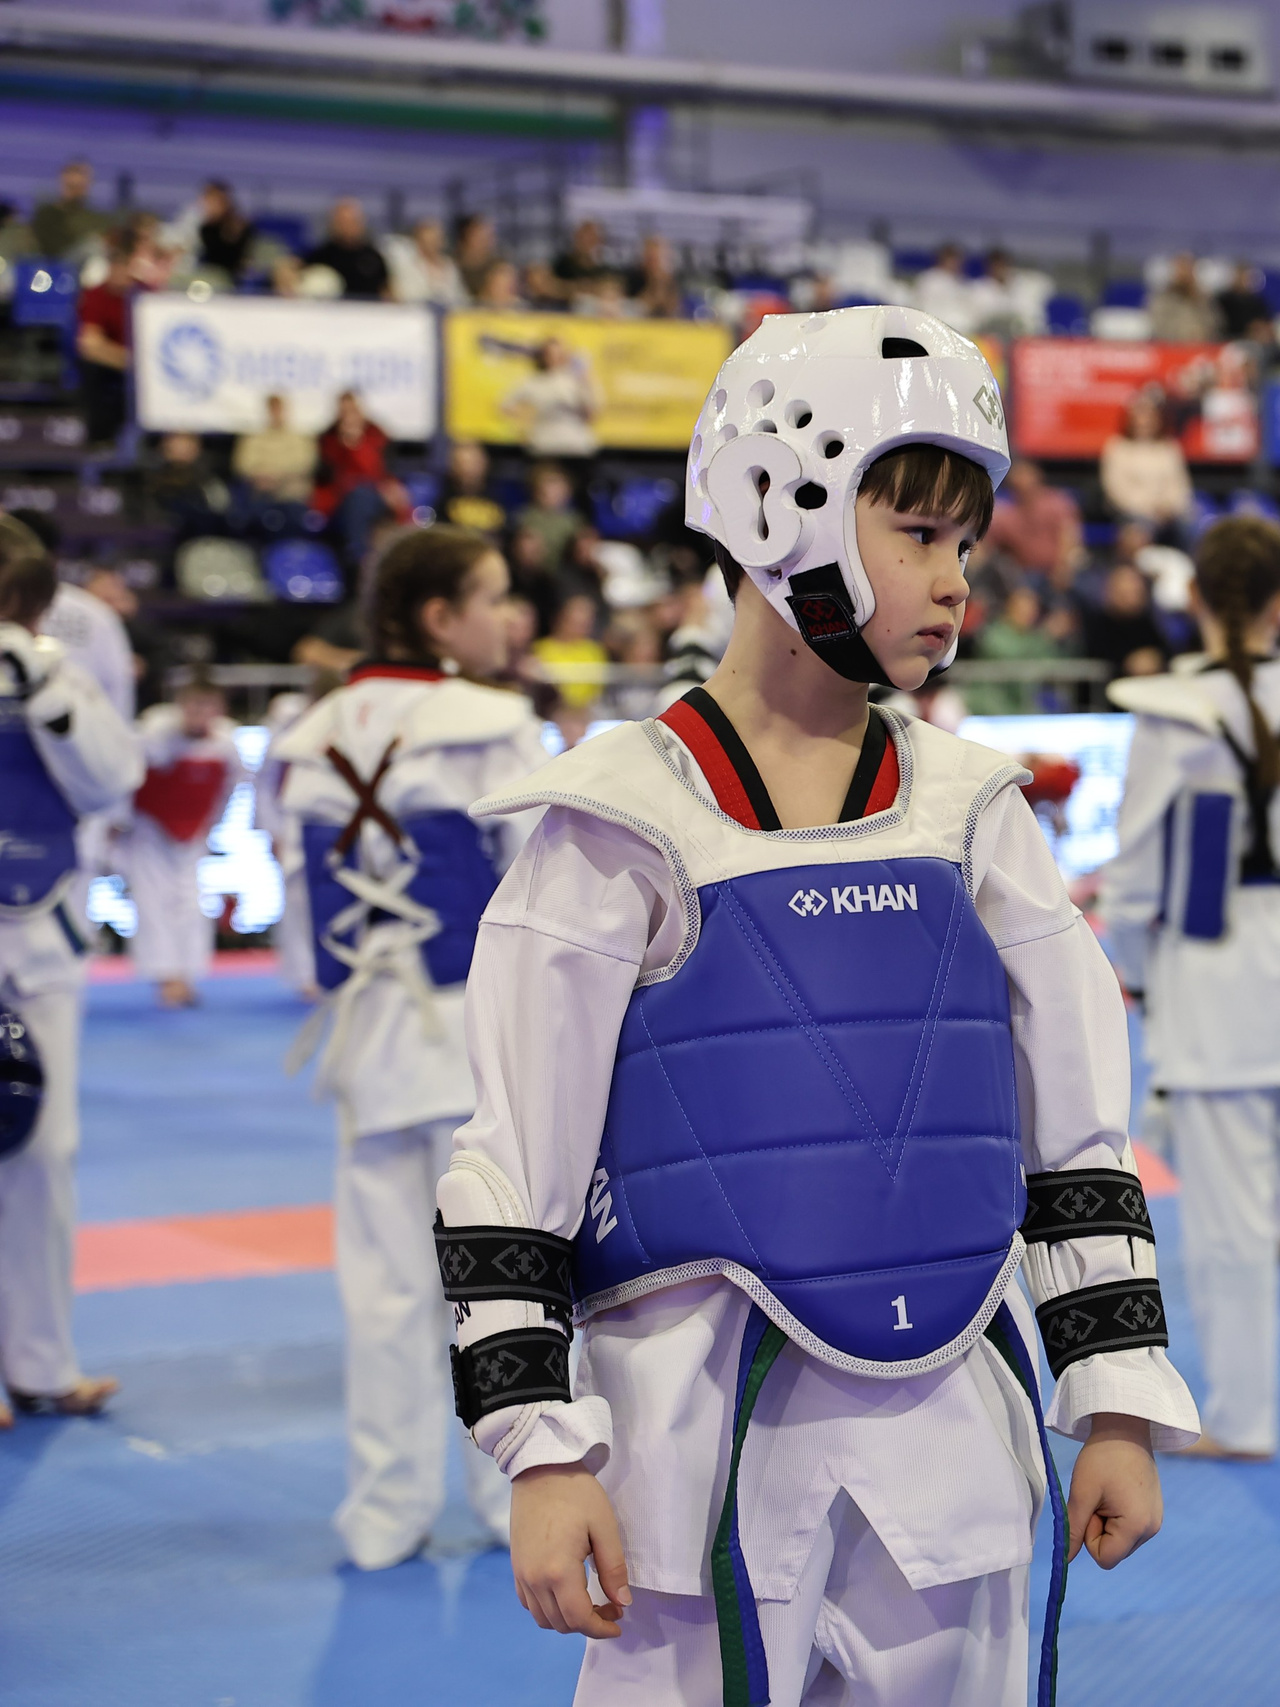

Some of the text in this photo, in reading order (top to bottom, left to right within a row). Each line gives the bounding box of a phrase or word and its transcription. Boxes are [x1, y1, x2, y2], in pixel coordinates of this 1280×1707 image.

[831, 884, 918, 914] KHAN
[589, 1166, 618, 1245] AN
[891, 1295, 913, 1331] 1
